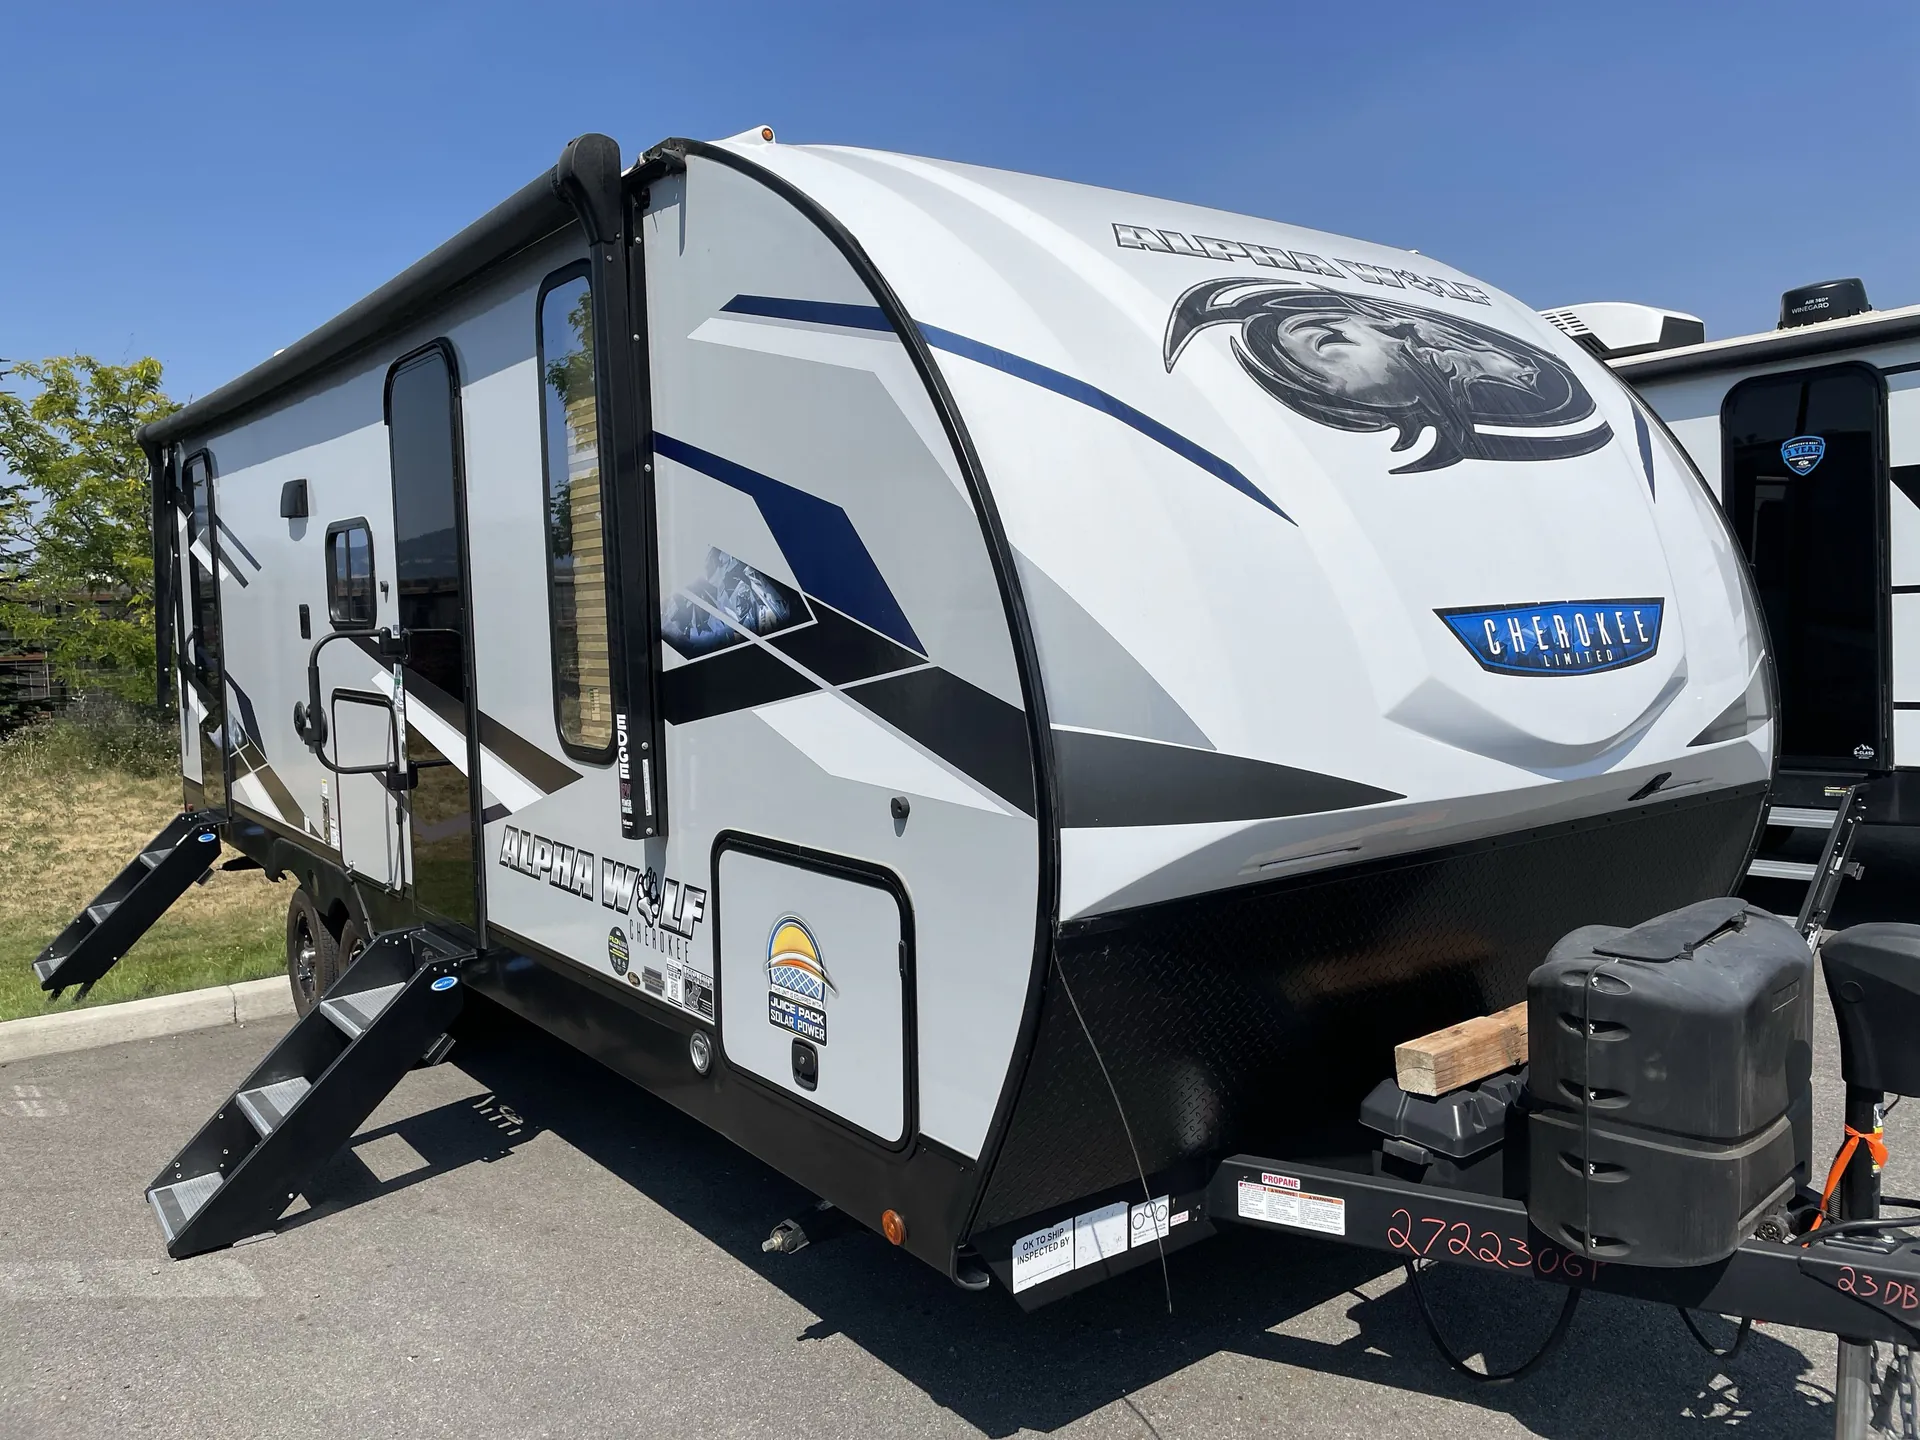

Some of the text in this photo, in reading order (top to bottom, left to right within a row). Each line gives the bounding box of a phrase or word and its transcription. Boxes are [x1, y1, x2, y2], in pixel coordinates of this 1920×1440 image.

[1111, 223, 1347, 279] ALPHA
[1791, 302, 1830, 314] WINEGARD
[1794, 445, 1821, 454] YEAR
[1483, 610, 1649, 655] CHEROKEE
[1543, 649, 1614, 667] LIMITED
[616, 713, 630, 779] EDGE
[499, 825, 595, 902] ALPHA
[629, 919, 689, 964] CHEROKEE
[770, 996, 825, 1026] JUICE PACK
[770, 1009, 826, 1041] SOLAR POWER
[1262, 1174, 1299, 1188] PROPANE
[1017, 1236, 1071, 1265] INSPECTED BY
[1022, 1227, 1065, 1251] OK TO SHIP
